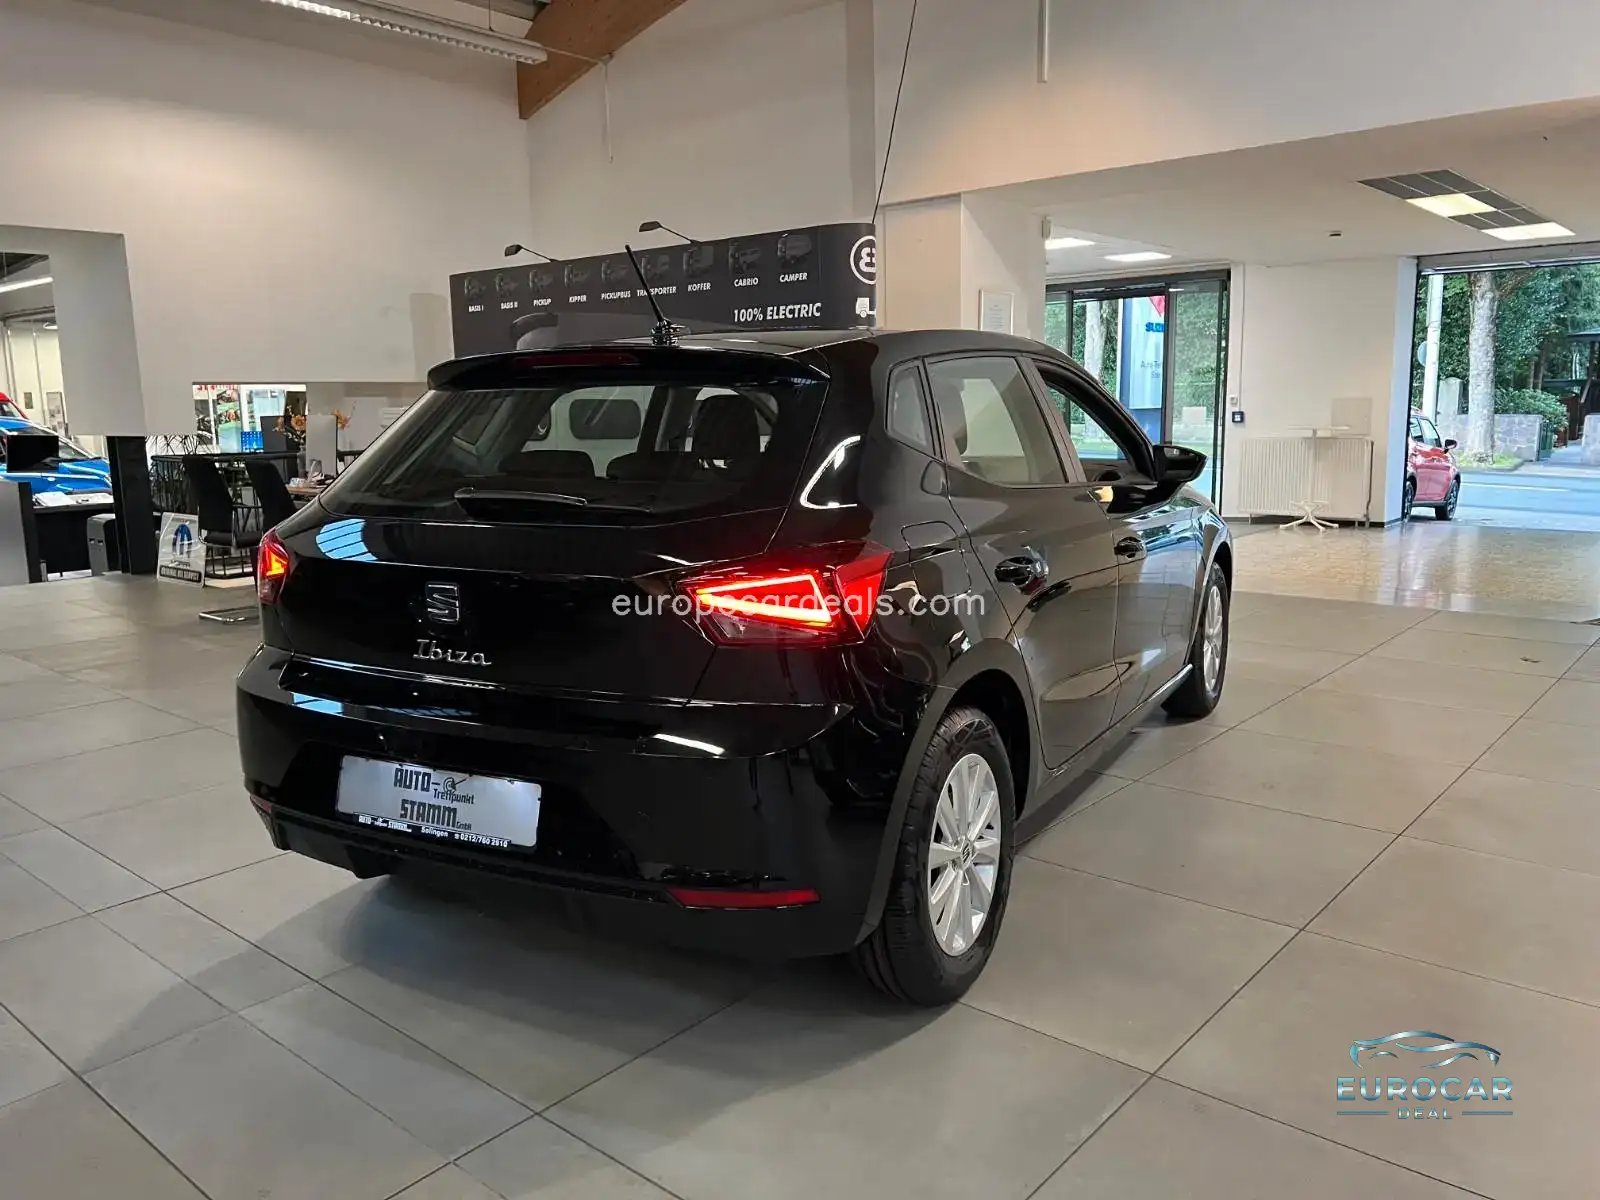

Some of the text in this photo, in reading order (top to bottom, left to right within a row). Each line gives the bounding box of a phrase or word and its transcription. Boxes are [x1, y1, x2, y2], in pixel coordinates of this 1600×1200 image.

[733, 277, 759, 287] CABRIO
[780, 272, 808, 283] CAMPER
[687, 282, 711, 292] KOFFER
[733, 302, 822, 322] 100% ELECTRIC
[413, 639, 492, 666] Ibiza
[433, 788, 475, 805] Treffpunkt
[400, 798, 457, 828] STAMM
